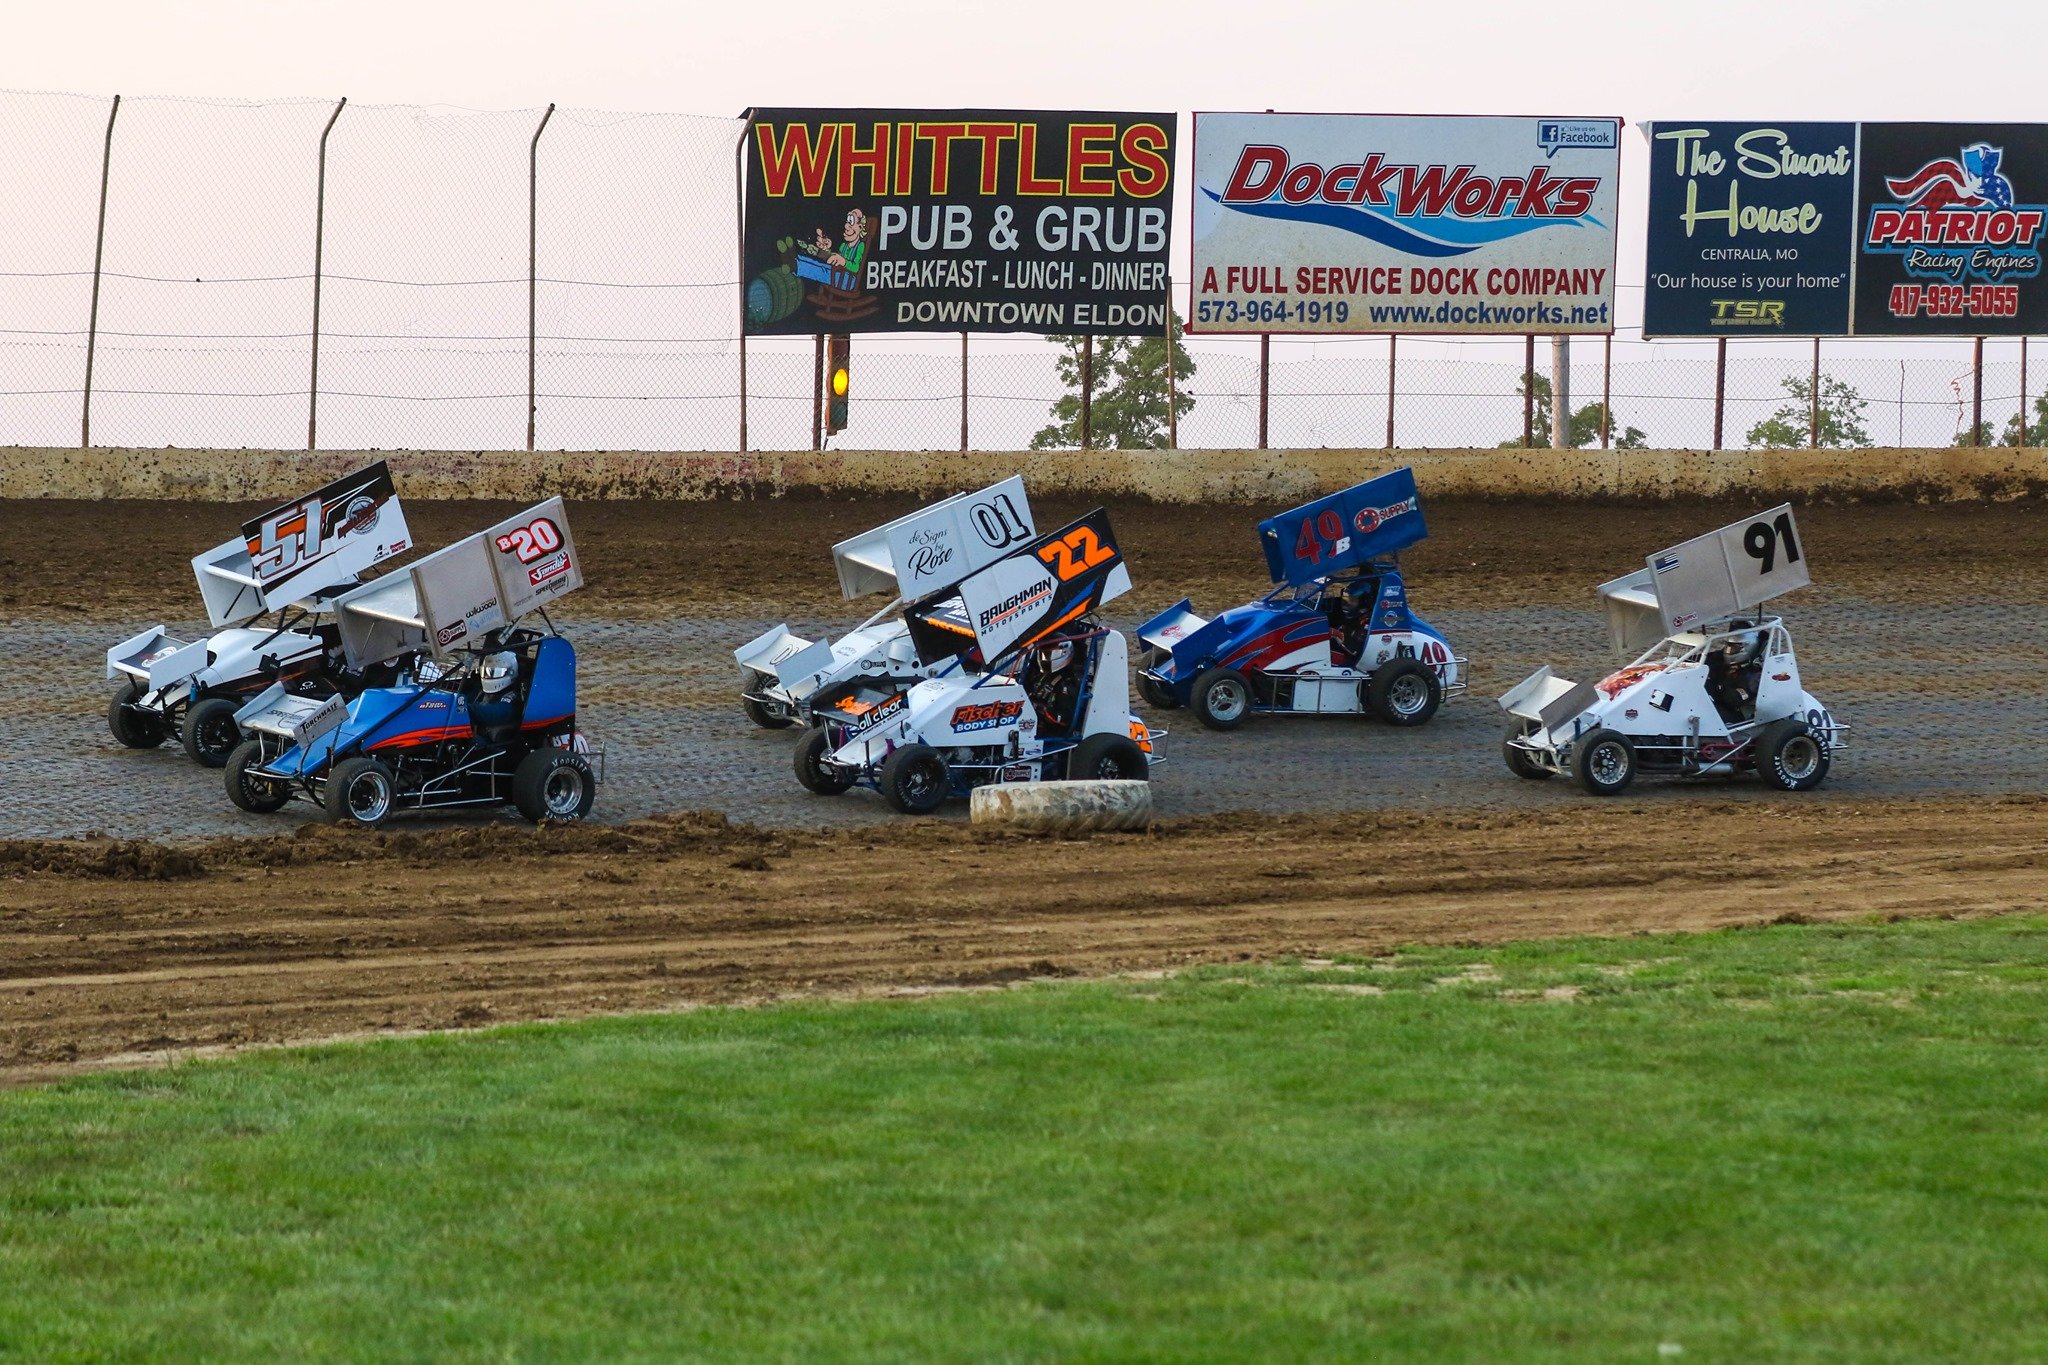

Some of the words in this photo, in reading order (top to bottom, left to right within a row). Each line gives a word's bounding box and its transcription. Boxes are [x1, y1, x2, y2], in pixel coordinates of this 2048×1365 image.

[1561, 132, 1609, 143] Facebook
[755, 122, 1169, 198] WHITTLES
[1655, 128, 1727, 177] The
[1733, 128, 1852, 180] Stuart
[1679, 178, 1823, 238] House
[878, 205, 973, 252] PUB
[988, 205, 1020, 252] &
[1035, 206, 1167, 254] GRUB
[1868, 210, 2043, 245] PATRIOT
[1701, 248, 1773, 262] CENTRALIA,
[1775, 248, 1799, 261] MO
[1908, 248, 1964, 271] Racing
[1971, 250, 2037, 277] Engines
[866, 260, 987, 290] BREAKFAST
[1004, 261, 1074, 290] LUNCH
[1091, 262, 1166, 291] DINNER
[1201, 266, 1219, 295] A
[1227, 266, 1288, 294] FULL
[1295, 267, 1401, 295] SERVICE
[1410, 268, 1478, 295] DOCK
[1487, 268, 1606, 296] COMPANY
[1691, 272, 1737, 288] house
[1741, 273, 1754, 288] is
[1757, 276, 1793, 293] your
[897, 301, 1065, 325] DOWNTOWN
[1073, 302, 1165, 326] ELDON
[1198, 301, 1349, 324] 573-964-1919
[1369, 301, 1608, 325] www.dockworks.net
[1711, 300, 1785, 320] TSR
[1888, 285, 2020, 317] 417-932-5055
[969, 494, 1031, 549] 01
[1379, 500, 1410, 520] SUPPLY
[259, 497, 323, 580] 51
[935, 541, 944, 551] by
[1037, 525, 1117, 583] 22
[1744, 512, 1799, 575] 91
[908, 546, 953, 580] Rose
[979, 577, 1052, 628] BAUGHMAN
[859, 711, 872, 730] all
[873, 699, 902, 722] clear
[957, 721, 986, 731] BODY
